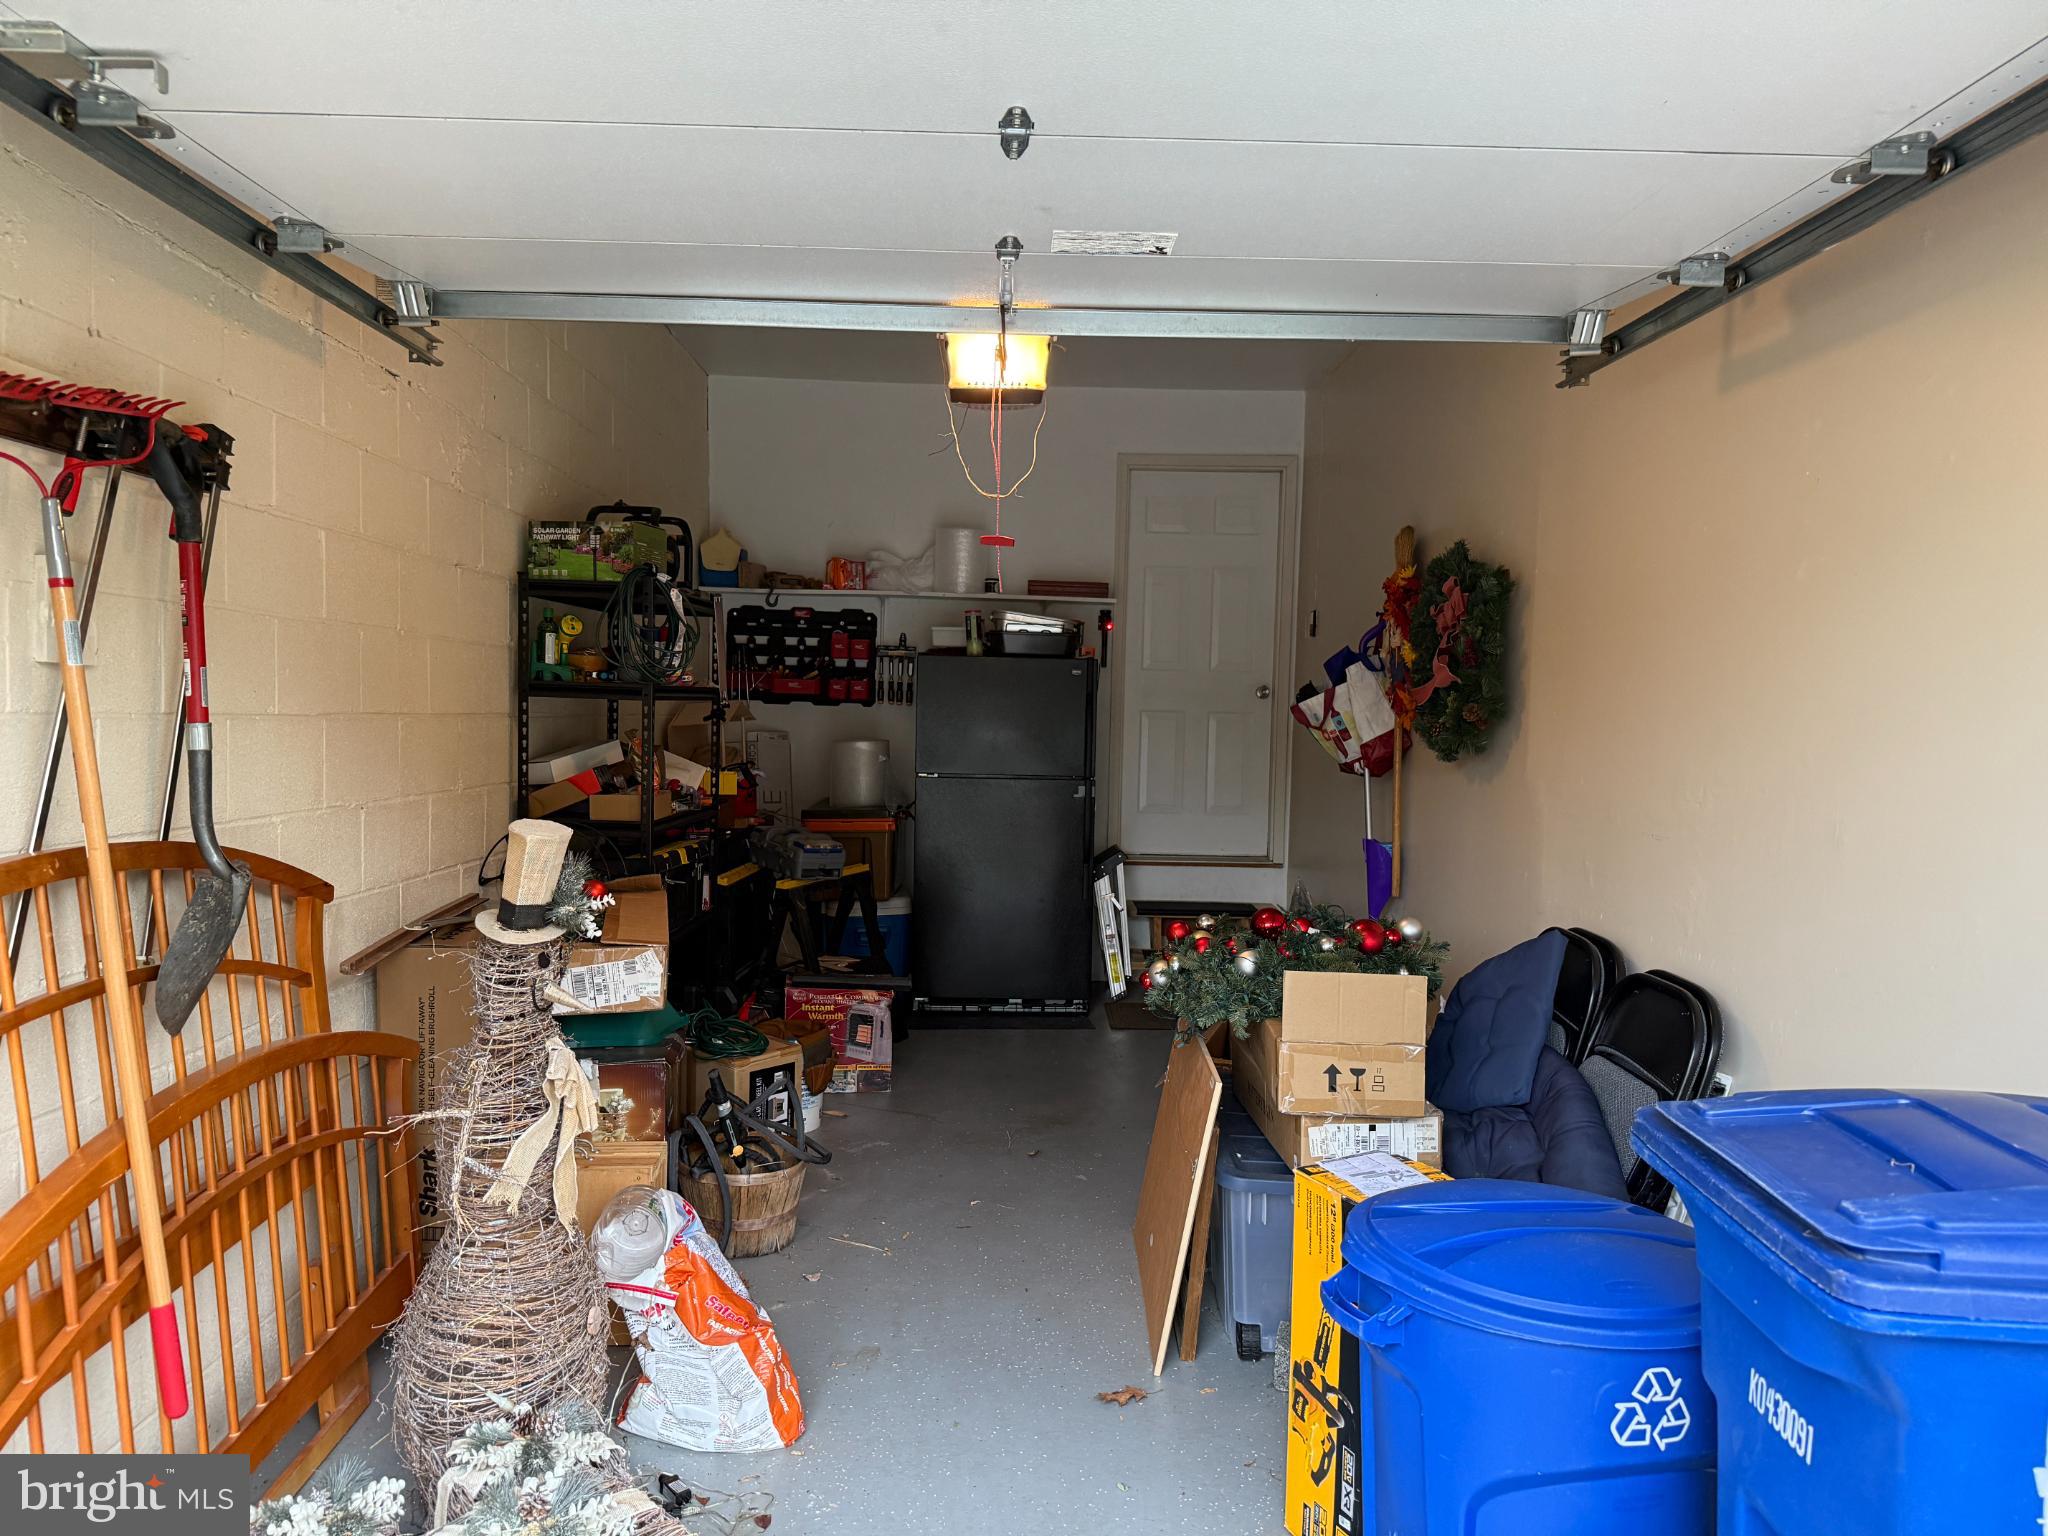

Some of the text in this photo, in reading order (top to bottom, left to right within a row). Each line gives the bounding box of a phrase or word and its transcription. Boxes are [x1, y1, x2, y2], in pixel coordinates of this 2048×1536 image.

[800, 1003, 835, 1011] Instant
[808, 1012, 844, 1020] Warmth
[418, 1048, 426, 1096] NAVIGATOR
[418, 1099, 426, 1125] SARK
[418, 1147, 438, 1217] Shark
